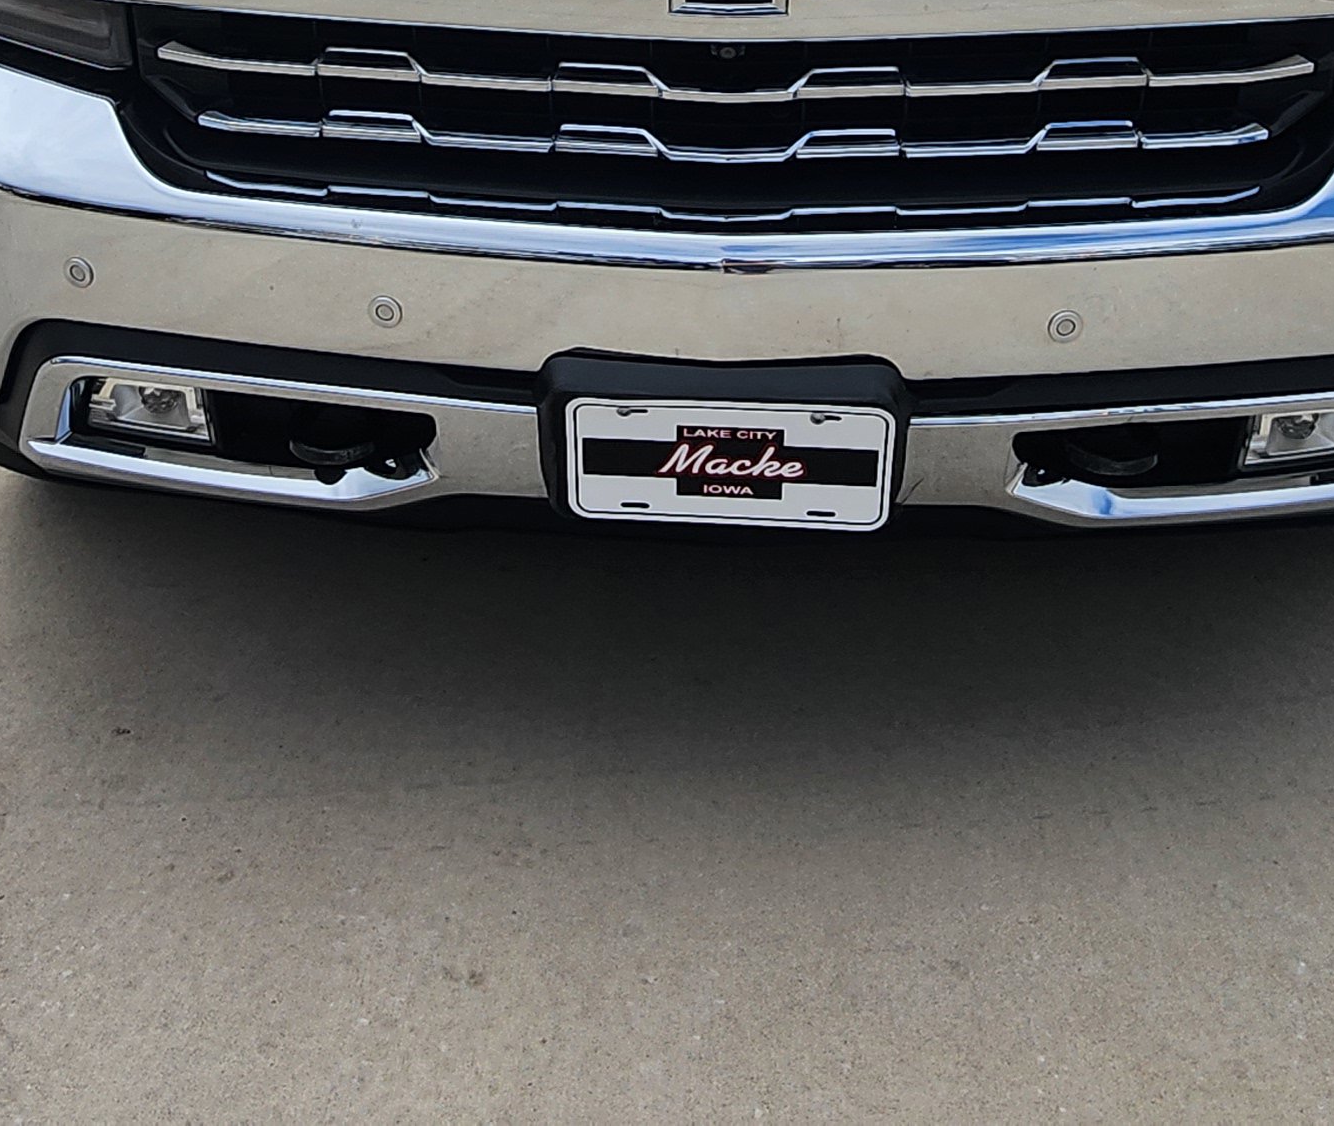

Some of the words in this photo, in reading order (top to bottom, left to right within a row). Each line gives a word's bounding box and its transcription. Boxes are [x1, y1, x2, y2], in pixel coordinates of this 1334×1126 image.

[683, 427, 732, 439] LAKE
[736, 428, 778, 441] CITY
[658, 443, 805, 478] Macke
[702, 483, 754, 496] IOWA
